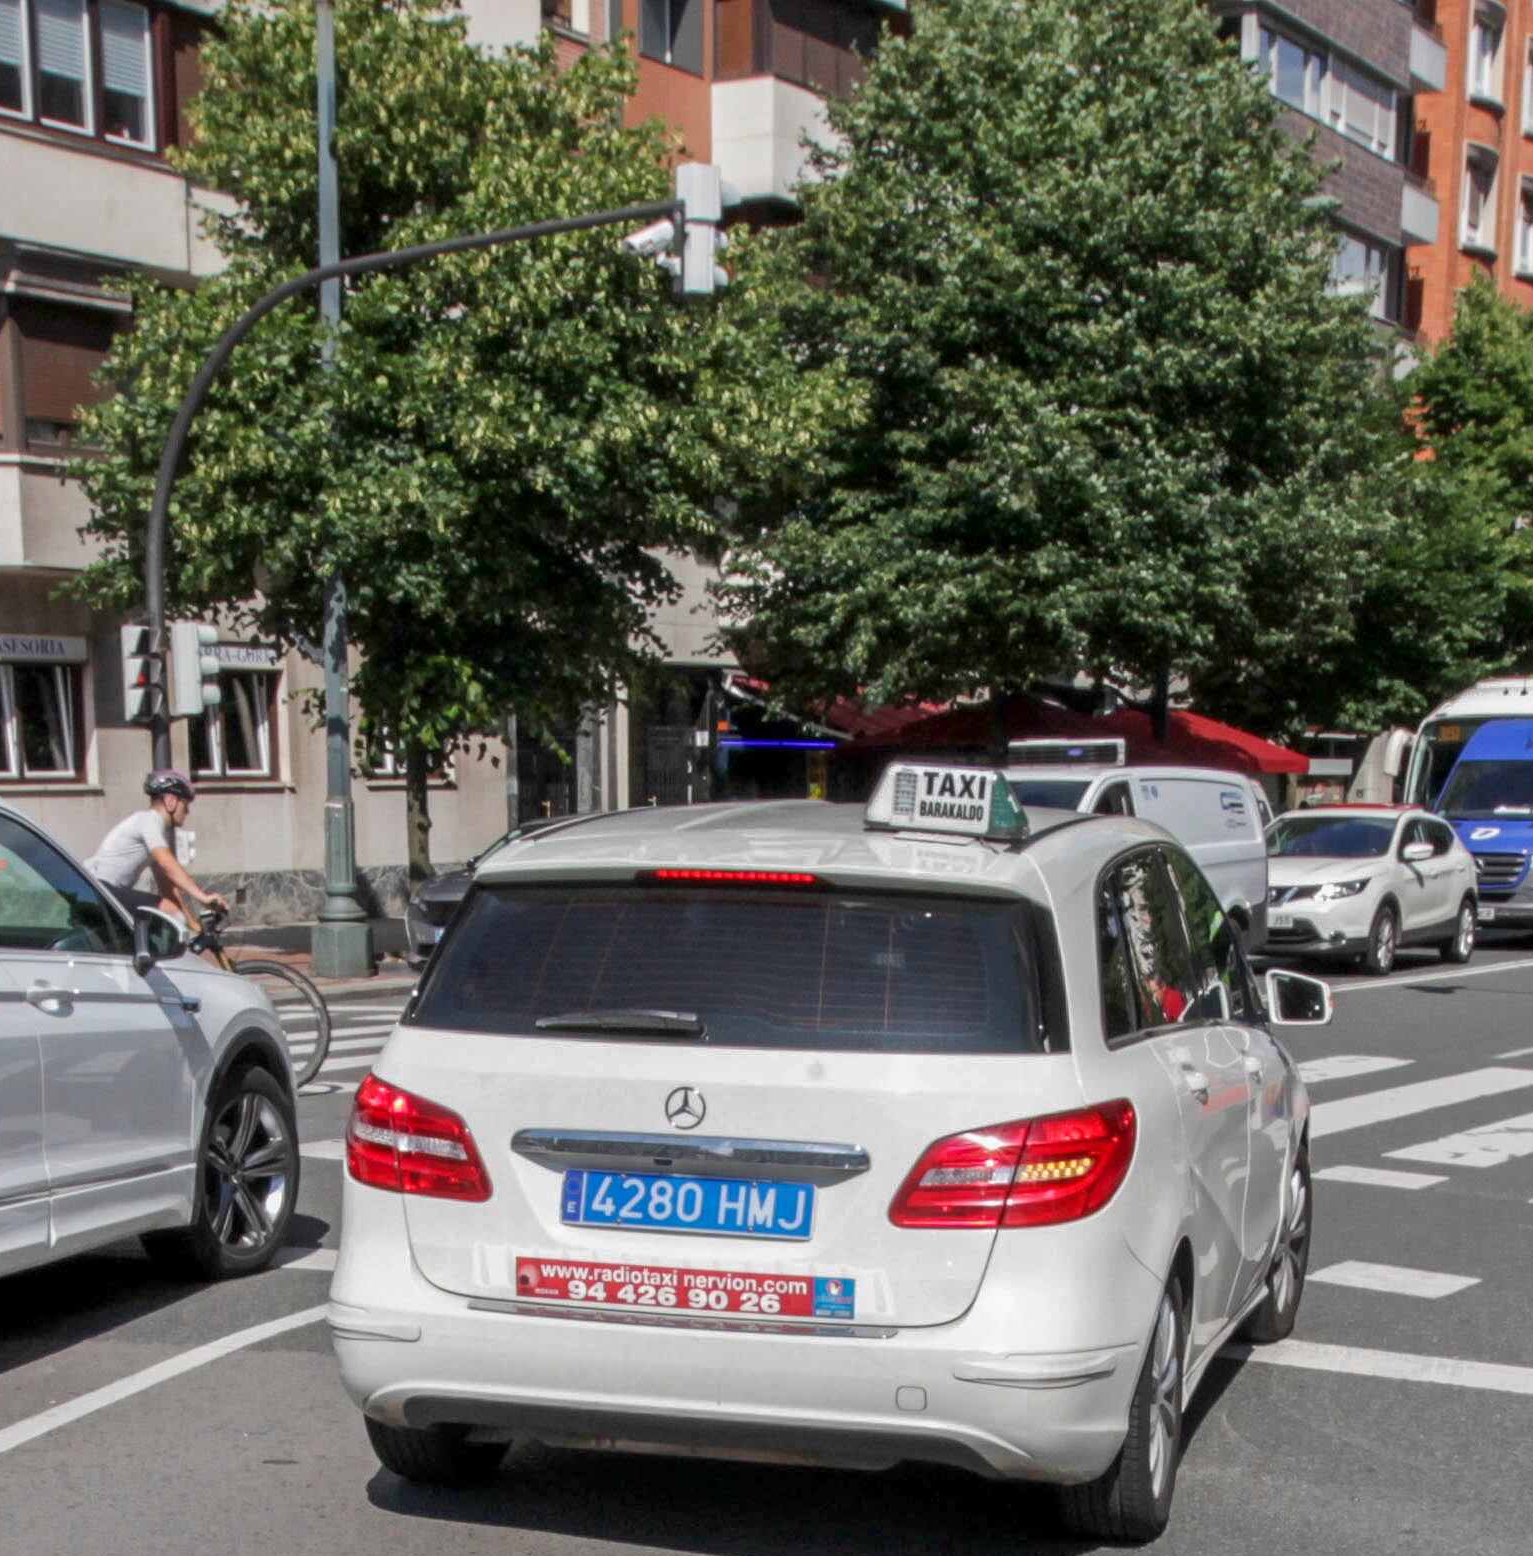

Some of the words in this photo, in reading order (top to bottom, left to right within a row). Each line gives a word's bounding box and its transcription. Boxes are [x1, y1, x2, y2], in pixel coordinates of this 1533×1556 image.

[923, 771, 987, 800] TAXI
[919, 800, 984, 821] BARAKALDO
[590, 1176, 703, 1222] 4280
[717, 1184, 807, 1231] HMJ
[567, 1280, 607, 1301] 94
[617, 1284, 677, 1306] 426
[688, 1288, 729, 1310] 90
[739, 1291, 781, 1314] 26
